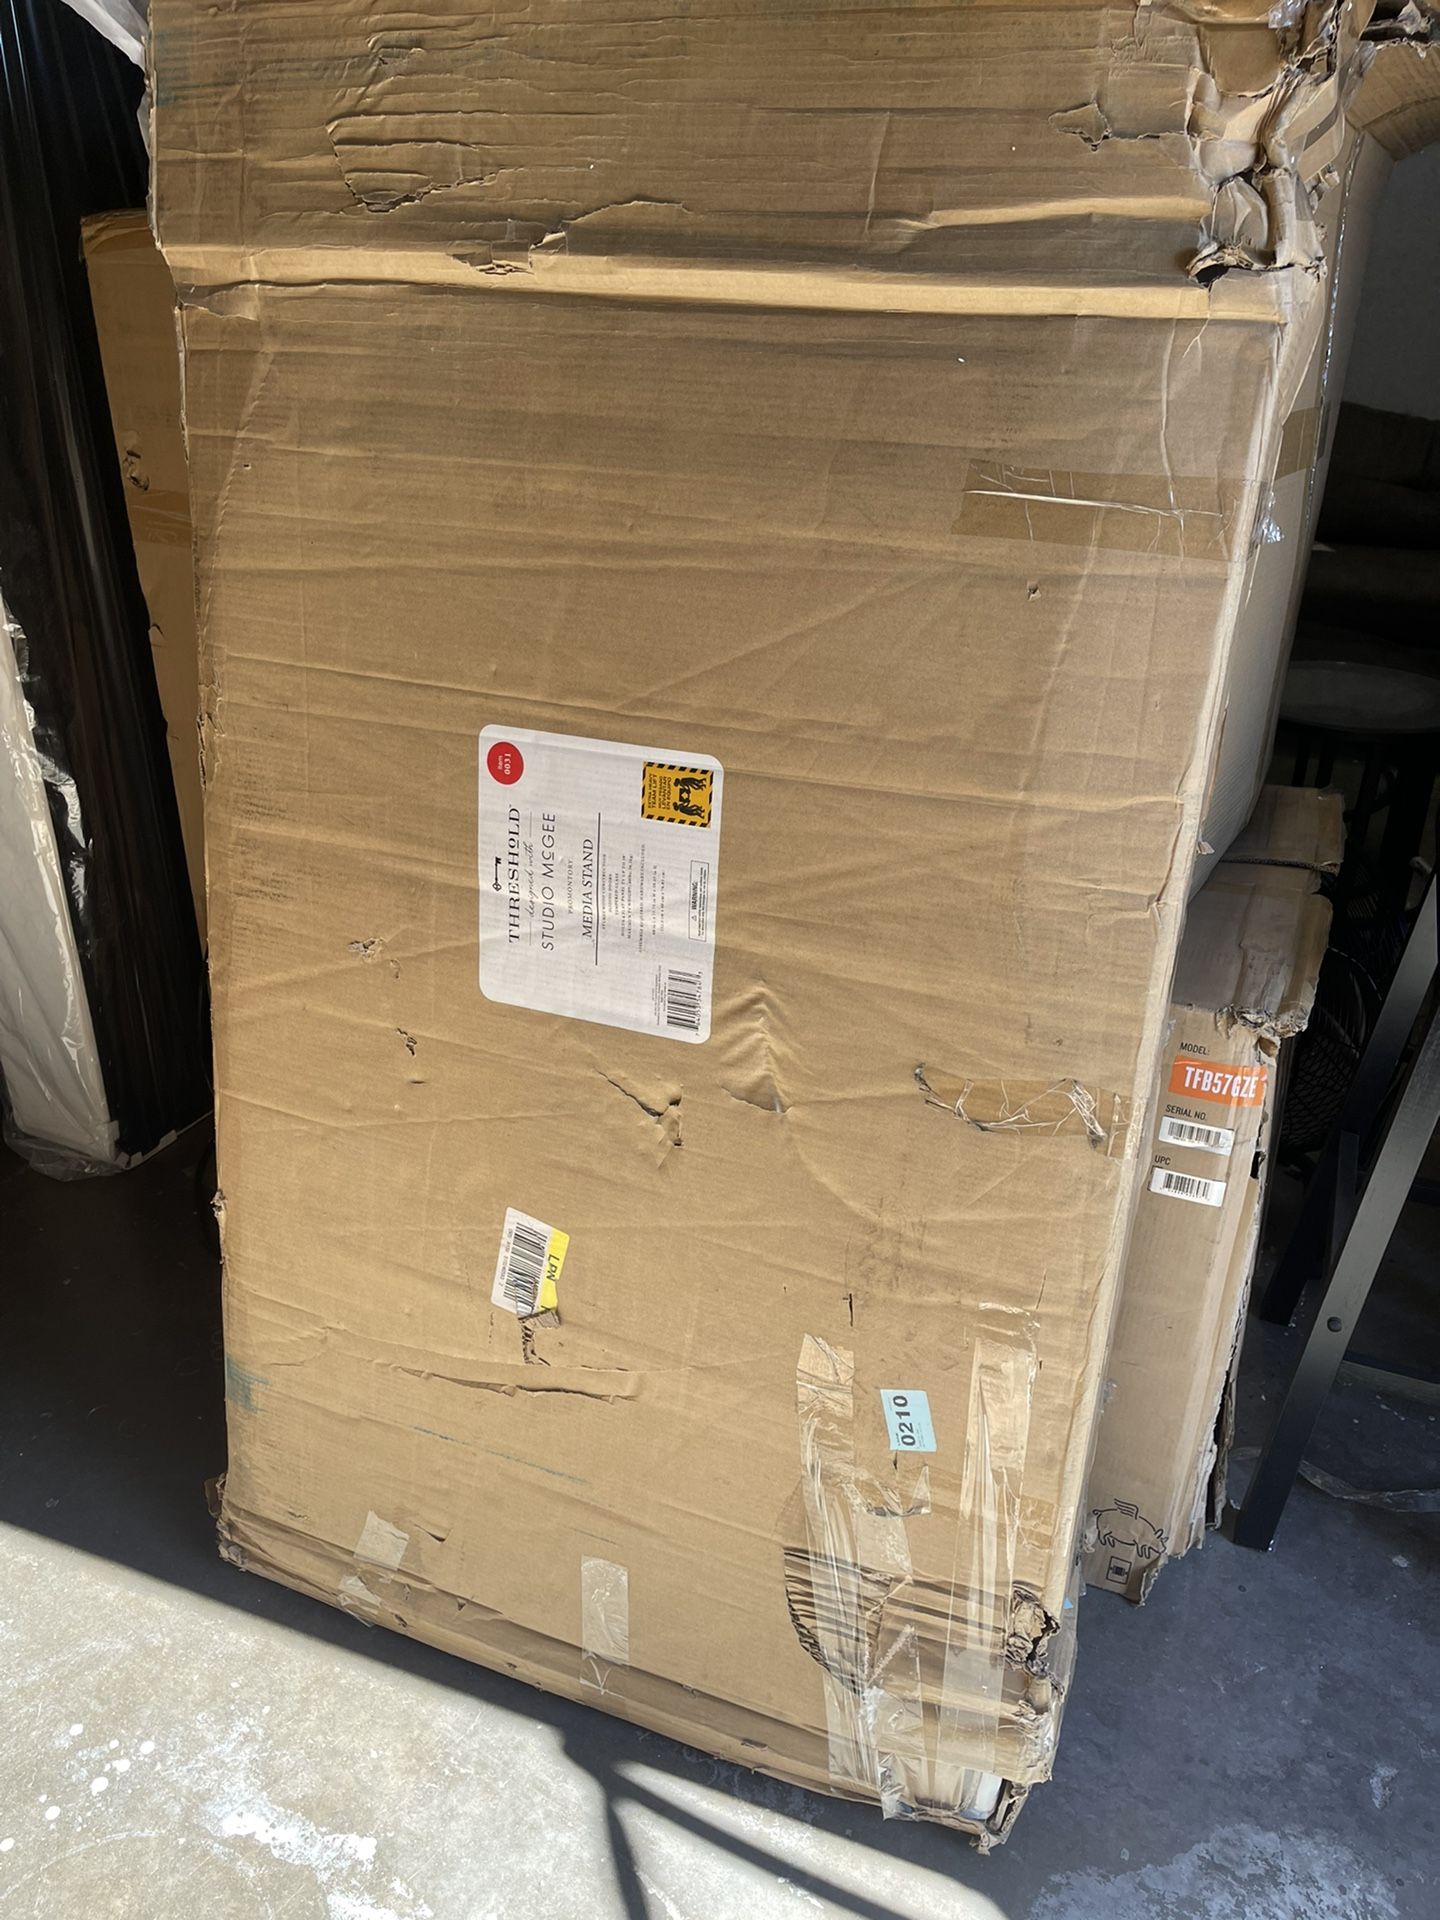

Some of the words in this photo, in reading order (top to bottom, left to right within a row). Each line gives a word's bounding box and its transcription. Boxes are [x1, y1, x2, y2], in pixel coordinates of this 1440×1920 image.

[504, 753, 512, 775] 0031
[523, 842, 534, 867] with
[582, 838, 594, 888] STAND
[508, 806, 521, 943] THRESHOLD
[524, 870, 538, 918] designed
[541, 885, 555, 951] STUDIO
[582, 891, 593, 938] MEDIA
[1179, 1042, 1210, 1056] MODEL:
[1184, 1066, 1259, 1098] TFB57GZE
[1165, 1104, 1193, 1118] SERIAL
[1154, 1154, 1172, 1166] UPC
[892, 1395, 916, 1446] 0210
